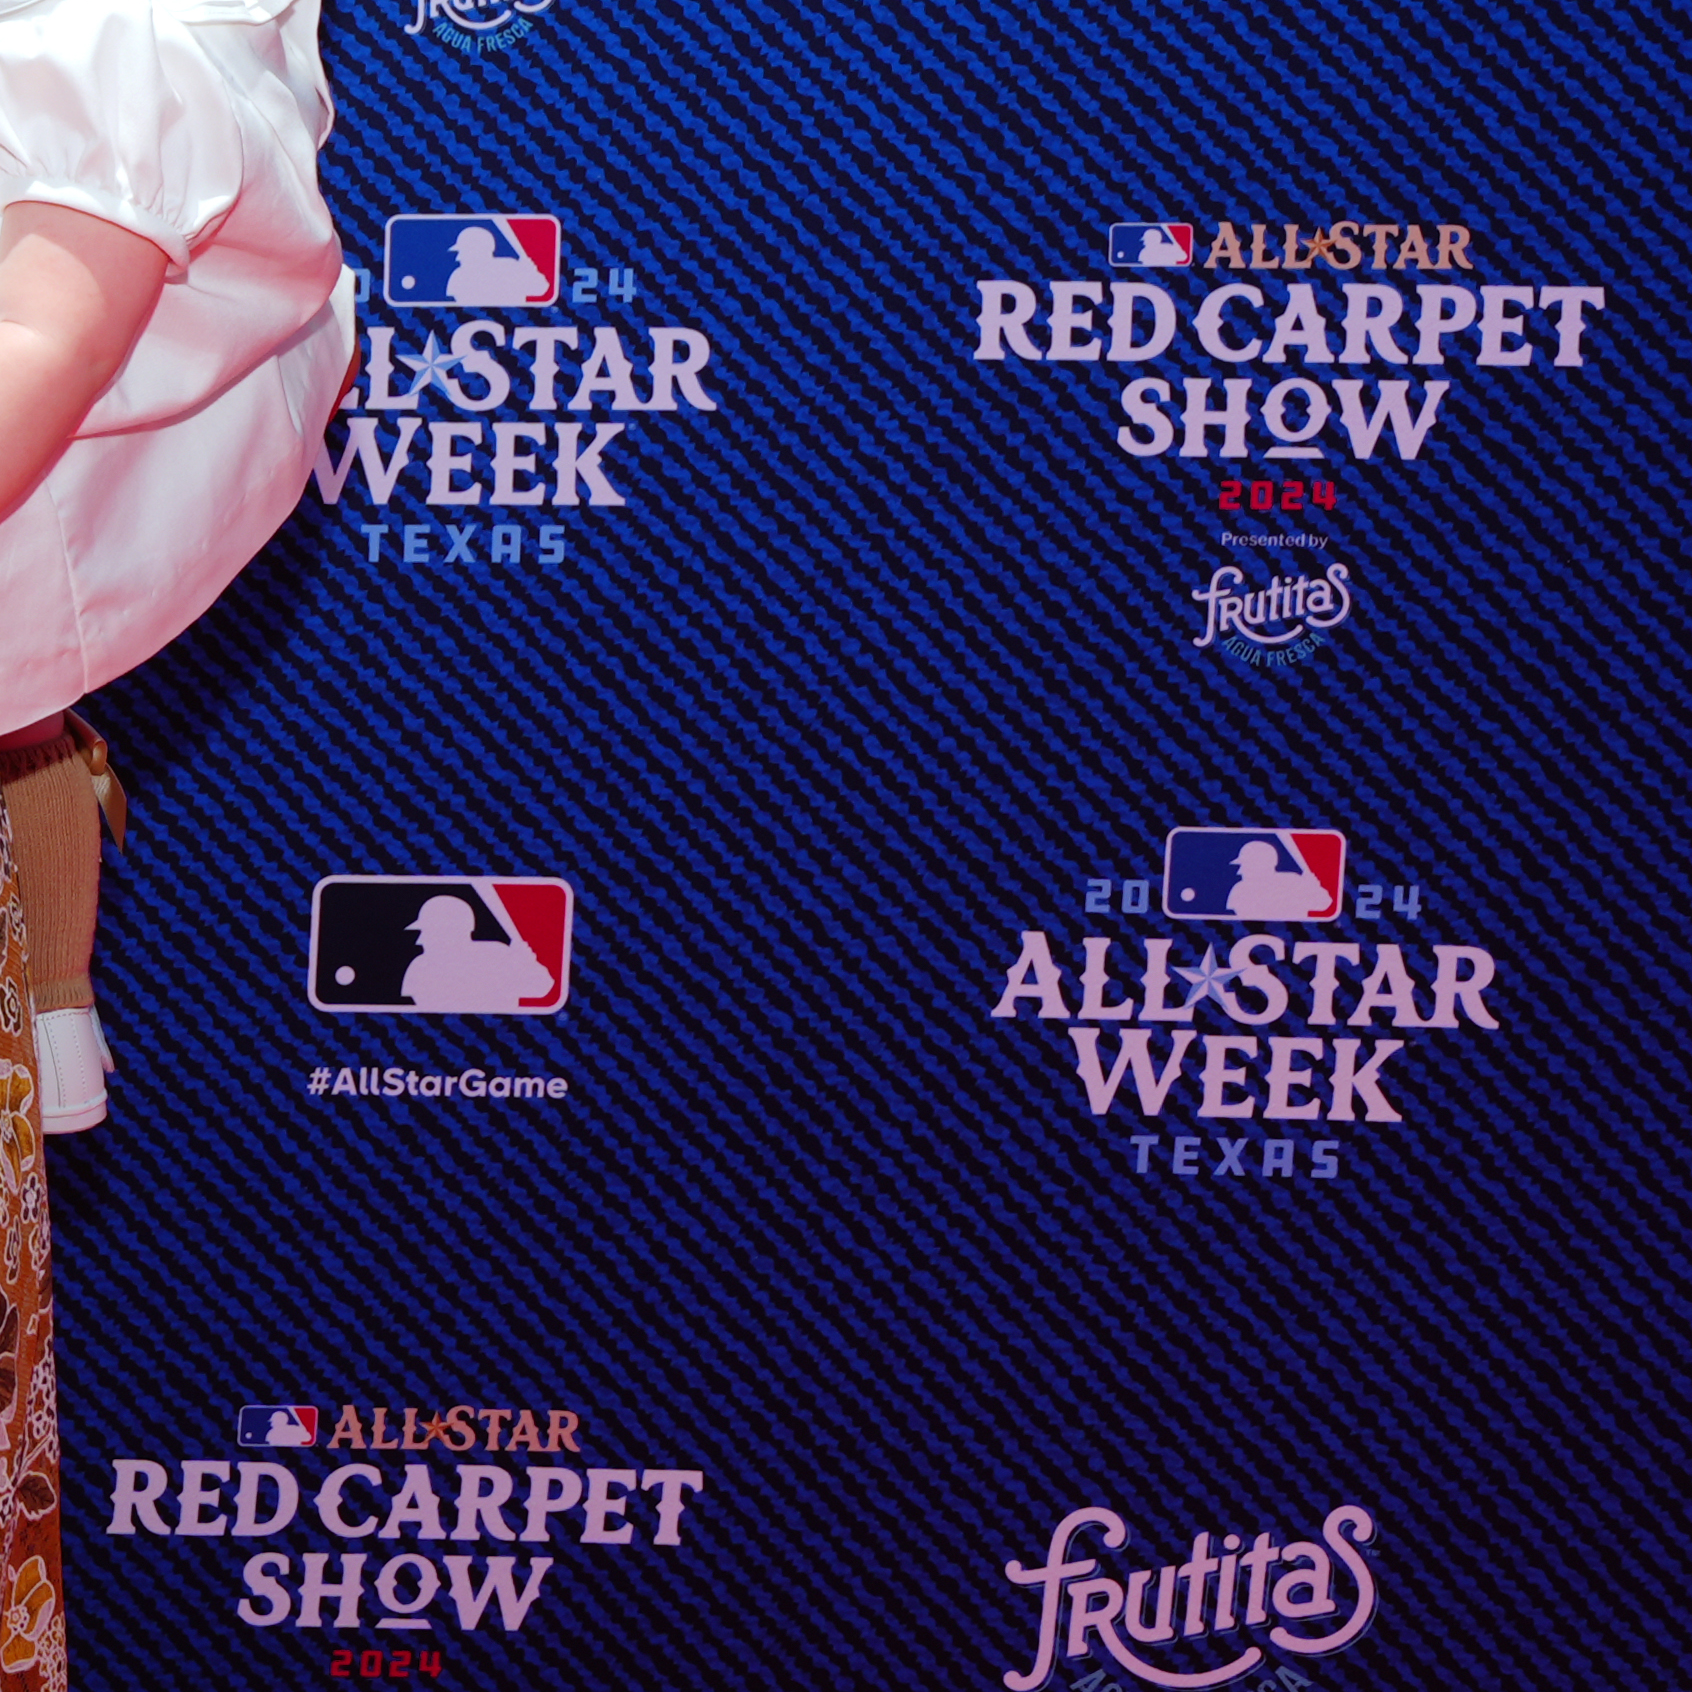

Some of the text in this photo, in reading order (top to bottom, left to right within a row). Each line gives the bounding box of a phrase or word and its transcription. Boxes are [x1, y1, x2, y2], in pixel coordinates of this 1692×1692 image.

[432, 16, 534, 53] AGUA FRESCA
[974, 280, 1605, 366] RED CARPET
[1117, 378, 1449, 460] SHOW
[313, 417, 625, 506] WEEK
[1218, 480, 1337, 511] 2024
[361, 524, 564, 563] TEXAS
[1221, 531, 1328, 550] Presented by
[1221, 631, 1326, 667] AGUA FRESCA
[1085, 879, 1421, 919] 20 24
[307, 1067, 568, 1098] #AllStarGame
[1067, 1027, 1405, 1122] WEEK
[1130, 1135, 1339, 1178] TEXAS
[107, 1459, 703, 1545] RED CARPET
[238, 1552, 553, 1630] SHOW
[330, 1649, 442, 1678] 2024
